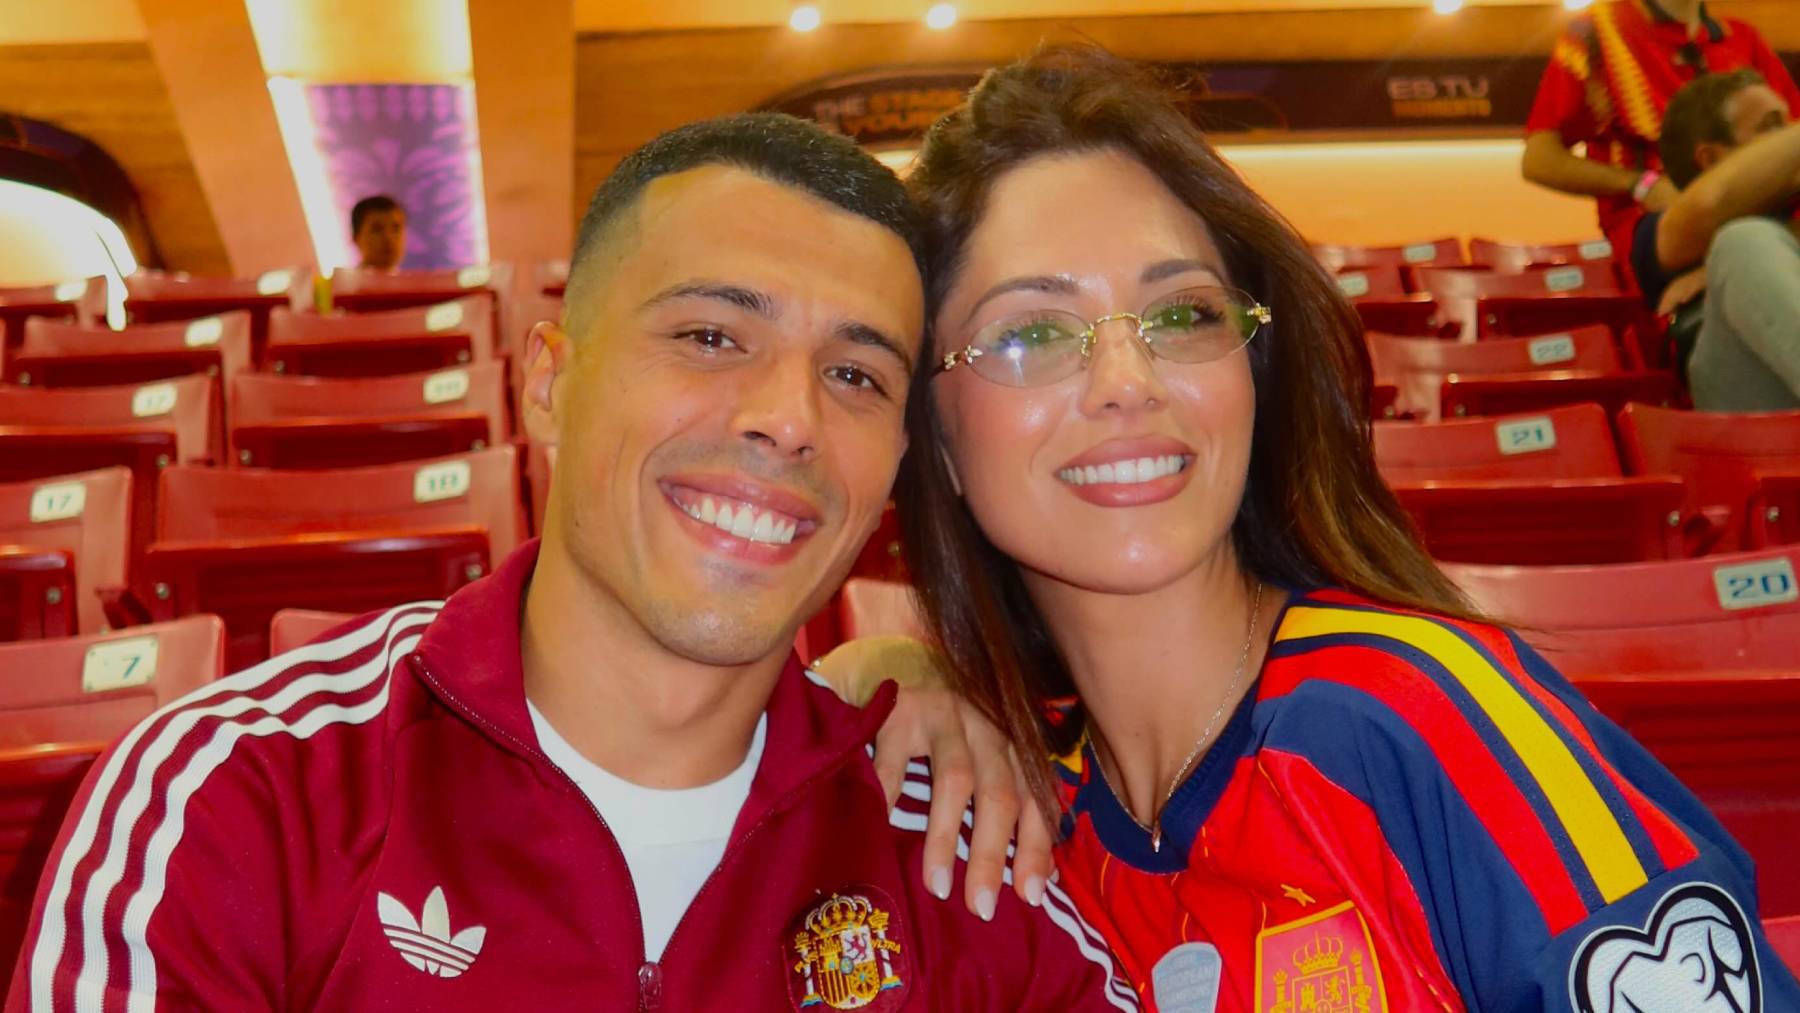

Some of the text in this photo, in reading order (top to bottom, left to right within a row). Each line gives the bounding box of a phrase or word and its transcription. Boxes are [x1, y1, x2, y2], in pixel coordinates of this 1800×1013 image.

[1511, 425, 1544, 447] 21
[47, 492, 73, 512] 17
[1728, 573, 1791, 600] 20
